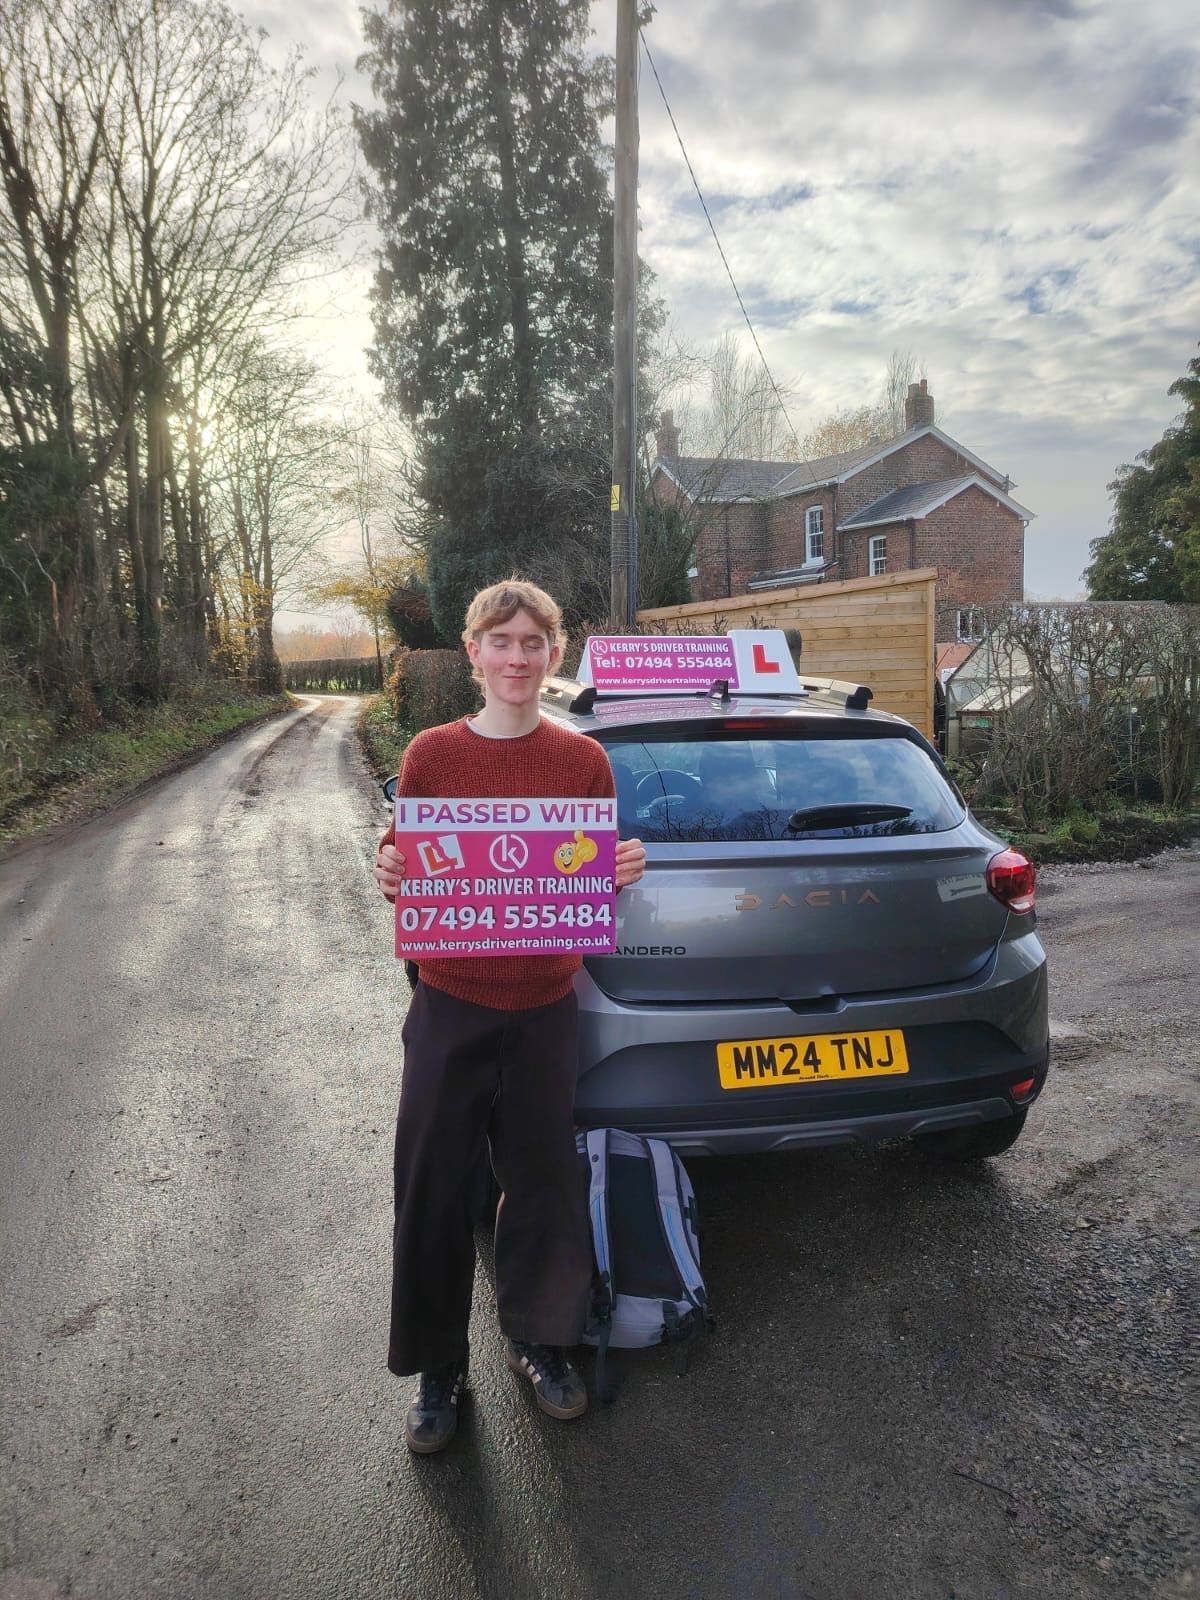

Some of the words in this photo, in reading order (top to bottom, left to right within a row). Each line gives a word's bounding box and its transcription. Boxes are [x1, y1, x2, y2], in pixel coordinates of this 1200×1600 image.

[610, 643, 649, 653] KERRY'S
[651, 643, 685, 653] DRIVER
[686, 643, 729, 652] TRAINING
[594, 656, 621, 668] Tel:
[625, 656, 673, 668] 07494
[677, 656, 732, 668] 555484
[753, 645, 780, 673] L
[596, 676, 735, 686] www.kerrysdrivertraining.cuk
[400, 804, 406, 824] I
[417, 803, 530, 823] PASSED
[539, 803, 613, 823] WITH
[401, 878, 471, 897] KERRY'S
[474, 877, 534, 896] DRIVER
[537, 876, 613, 894] TRAINING
[735, 888, 881, 911] DACIA
[401, 905, 496, 931] 07494
[503, 903, 612, 929] 555484
[401, 934, 611, 953] www.kerrysdrivertraining.co.uk
[609, 946, 686, 956] ANDERO
[733, 1041, 822, 1079] MM24
[831, 1035, 894, 1071] TNJ
